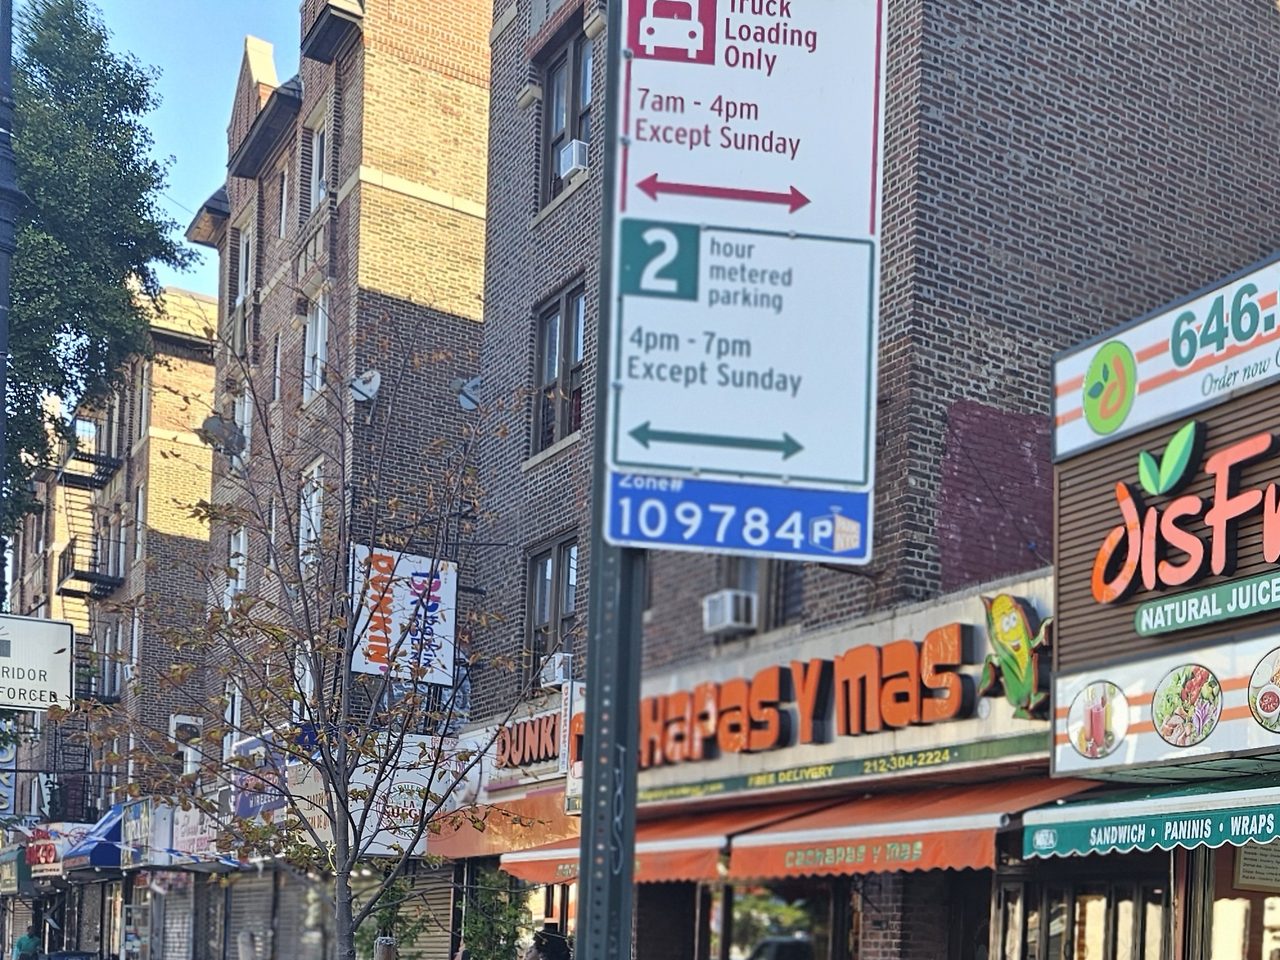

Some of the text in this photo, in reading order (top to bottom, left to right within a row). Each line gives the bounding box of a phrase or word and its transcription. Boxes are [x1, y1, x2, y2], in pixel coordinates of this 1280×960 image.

[725, 18, 817, 53] Loading
[724, 45, 777, 77] Only
[637, 87, 685, 114] 7am
[710, 95, 759, 122] 4pm
[635, 118, 801, 161] Except Sunday
[639, 228, 679, 293] 2
[709, 237, 756, 259] hour
[709, 264, 793, 287] metered
[708, 287, 783, 315] parking
[629, 325, 680, 354] 4pm
[702, 331, 751, 360] 7pm
[627, 355, 802, 398] Except Sunday
[1201, 366, 1239, 397] Order
[1241, 357, 1271, 386] now
[619, 497, 805, 549] 109784
[1141, 593, 1222, 633] NATURAL
[793, 661, 822, 744] Y
[778, 765, 835, 783] DELIVERY
[864, 749, 951, 774] 212-304-2224
[1090, 824, 1146, 846] SANDWICH
[1164, 818, 1212, 841] PANINIS
[1230, 815, 1274, 836] WRAPS
